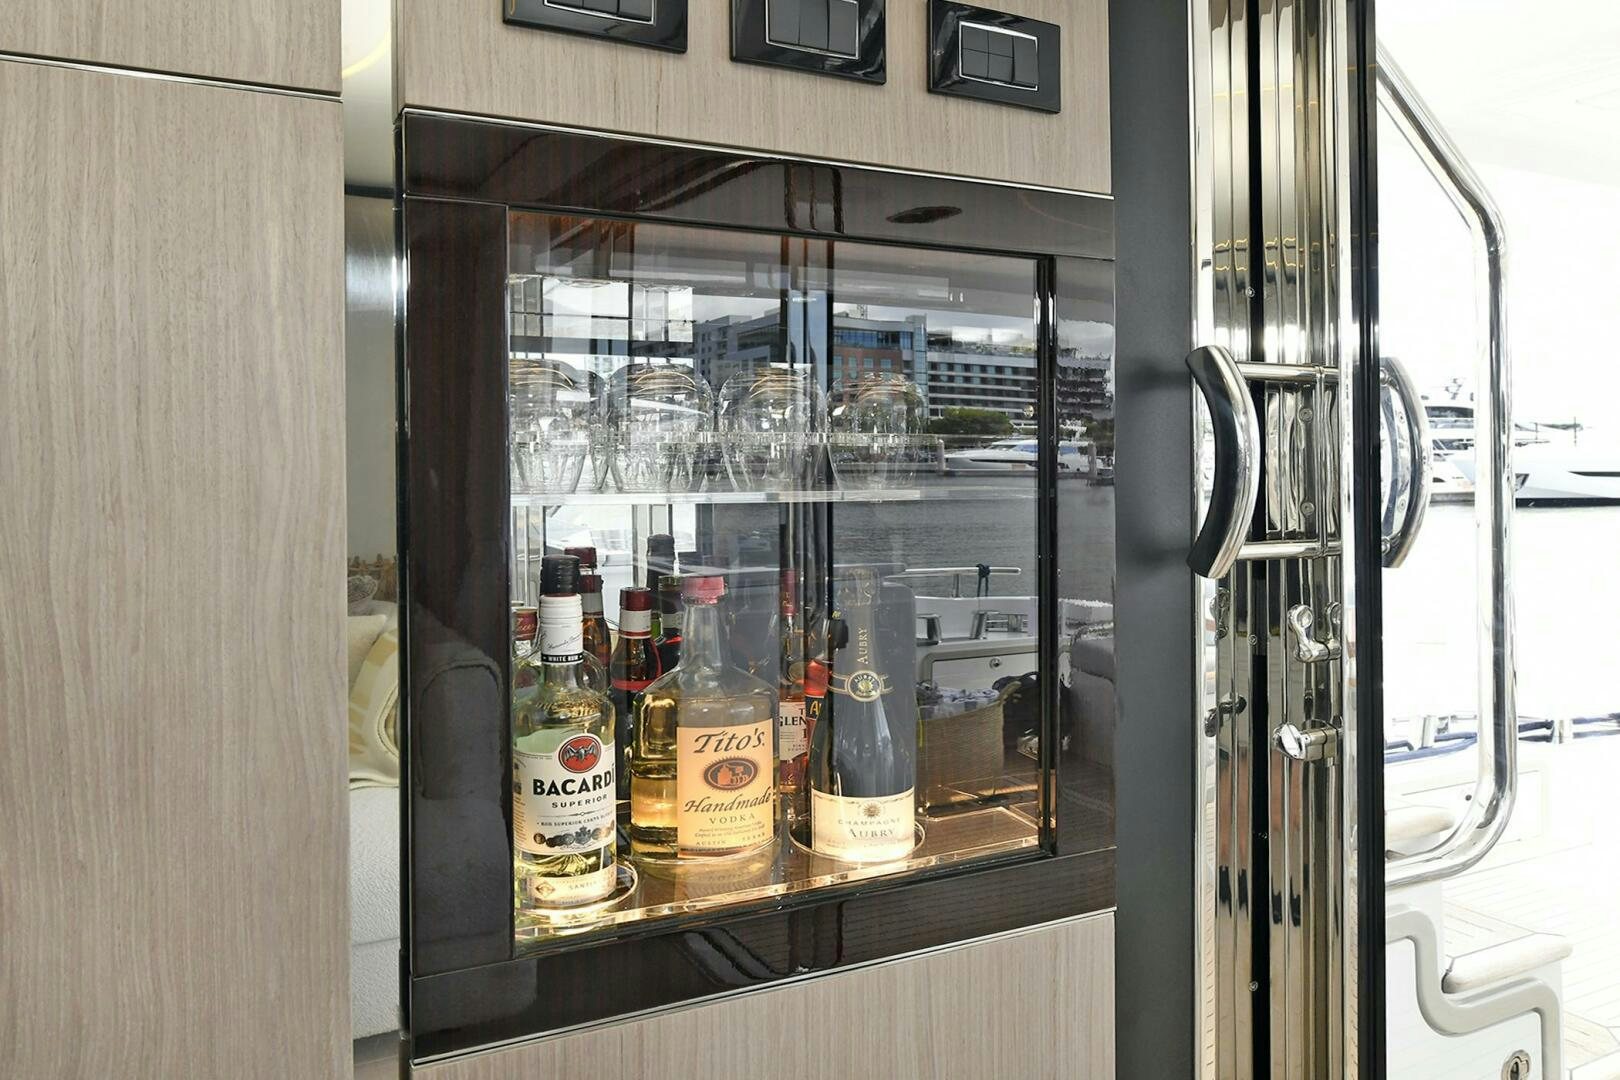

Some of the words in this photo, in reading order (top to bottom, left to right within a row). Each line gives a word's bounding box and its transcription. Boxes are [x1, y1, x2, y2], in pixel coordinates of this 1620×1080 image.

[857, 627, 869, 664] AUBRY
[693, 728, 765, 753] Tito's
[552, 794, 607, 809] SUPERIOR
[683, 786, 772, 813] Handmade
[709, 813, 756, 824] VODKA
[838, 817, 900, 826] CHAMPAGNE
[848, 828, 894, 838] AUBRY
